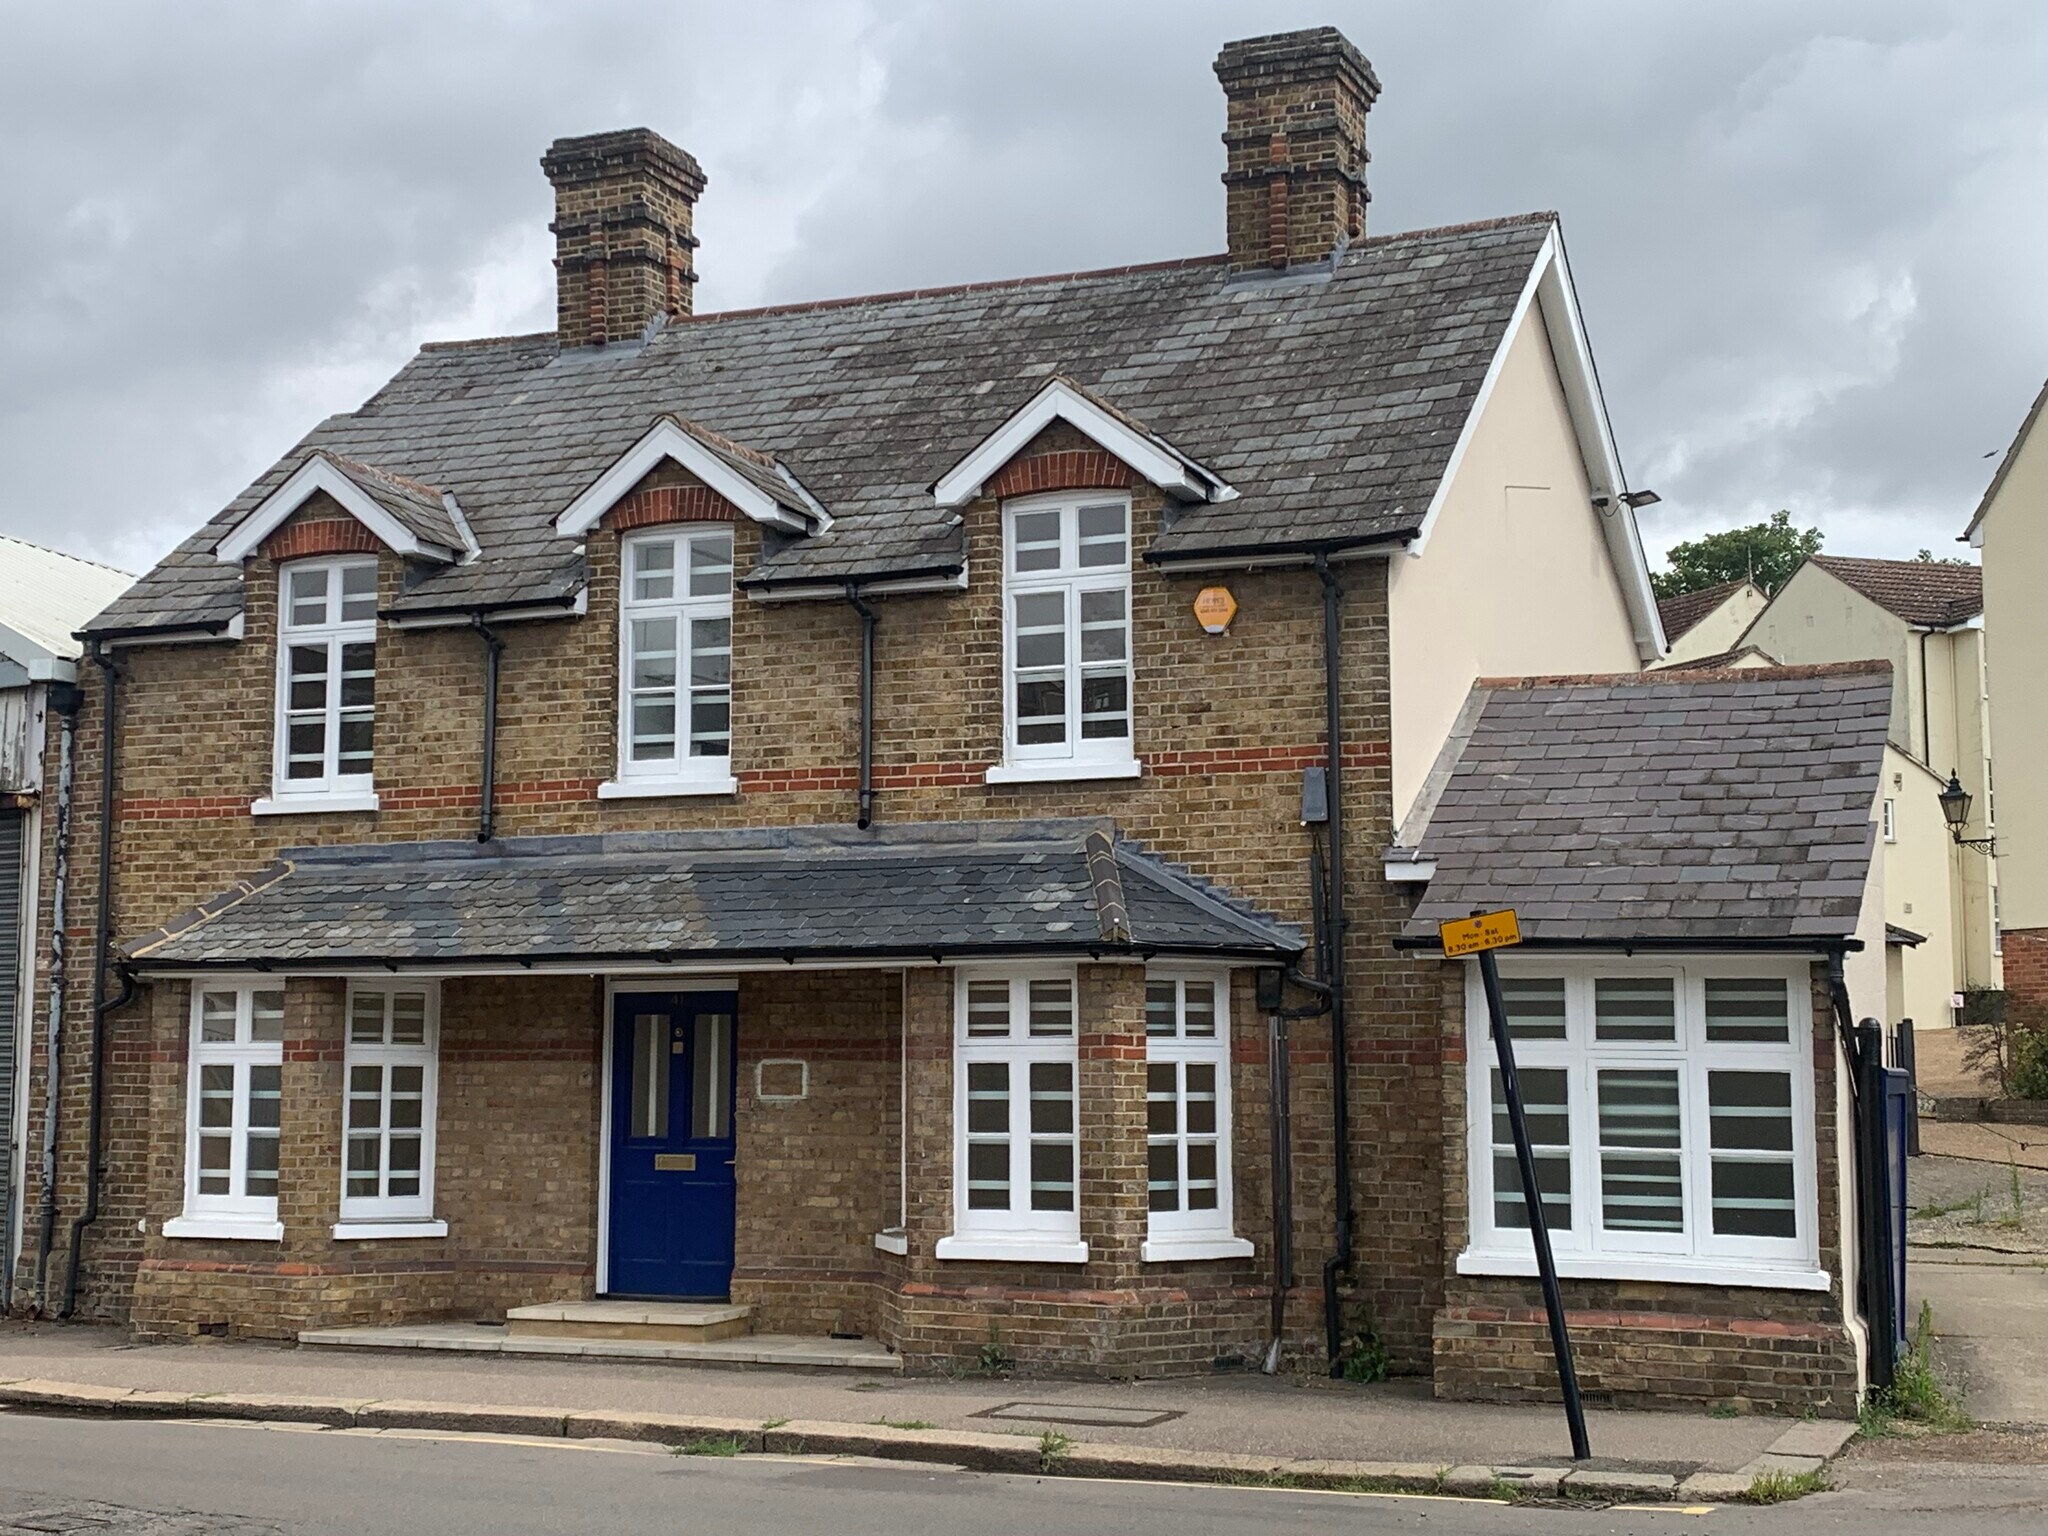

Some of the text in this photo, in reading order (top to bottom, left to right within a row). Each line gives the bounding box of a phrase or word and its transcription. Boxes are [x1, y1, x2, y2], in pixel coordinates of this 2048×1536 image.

[1462, 933, 1479, 941] Mon
[1485, 928, 1499, 936] Sat
[1504, 934, 1517, 942] pm
